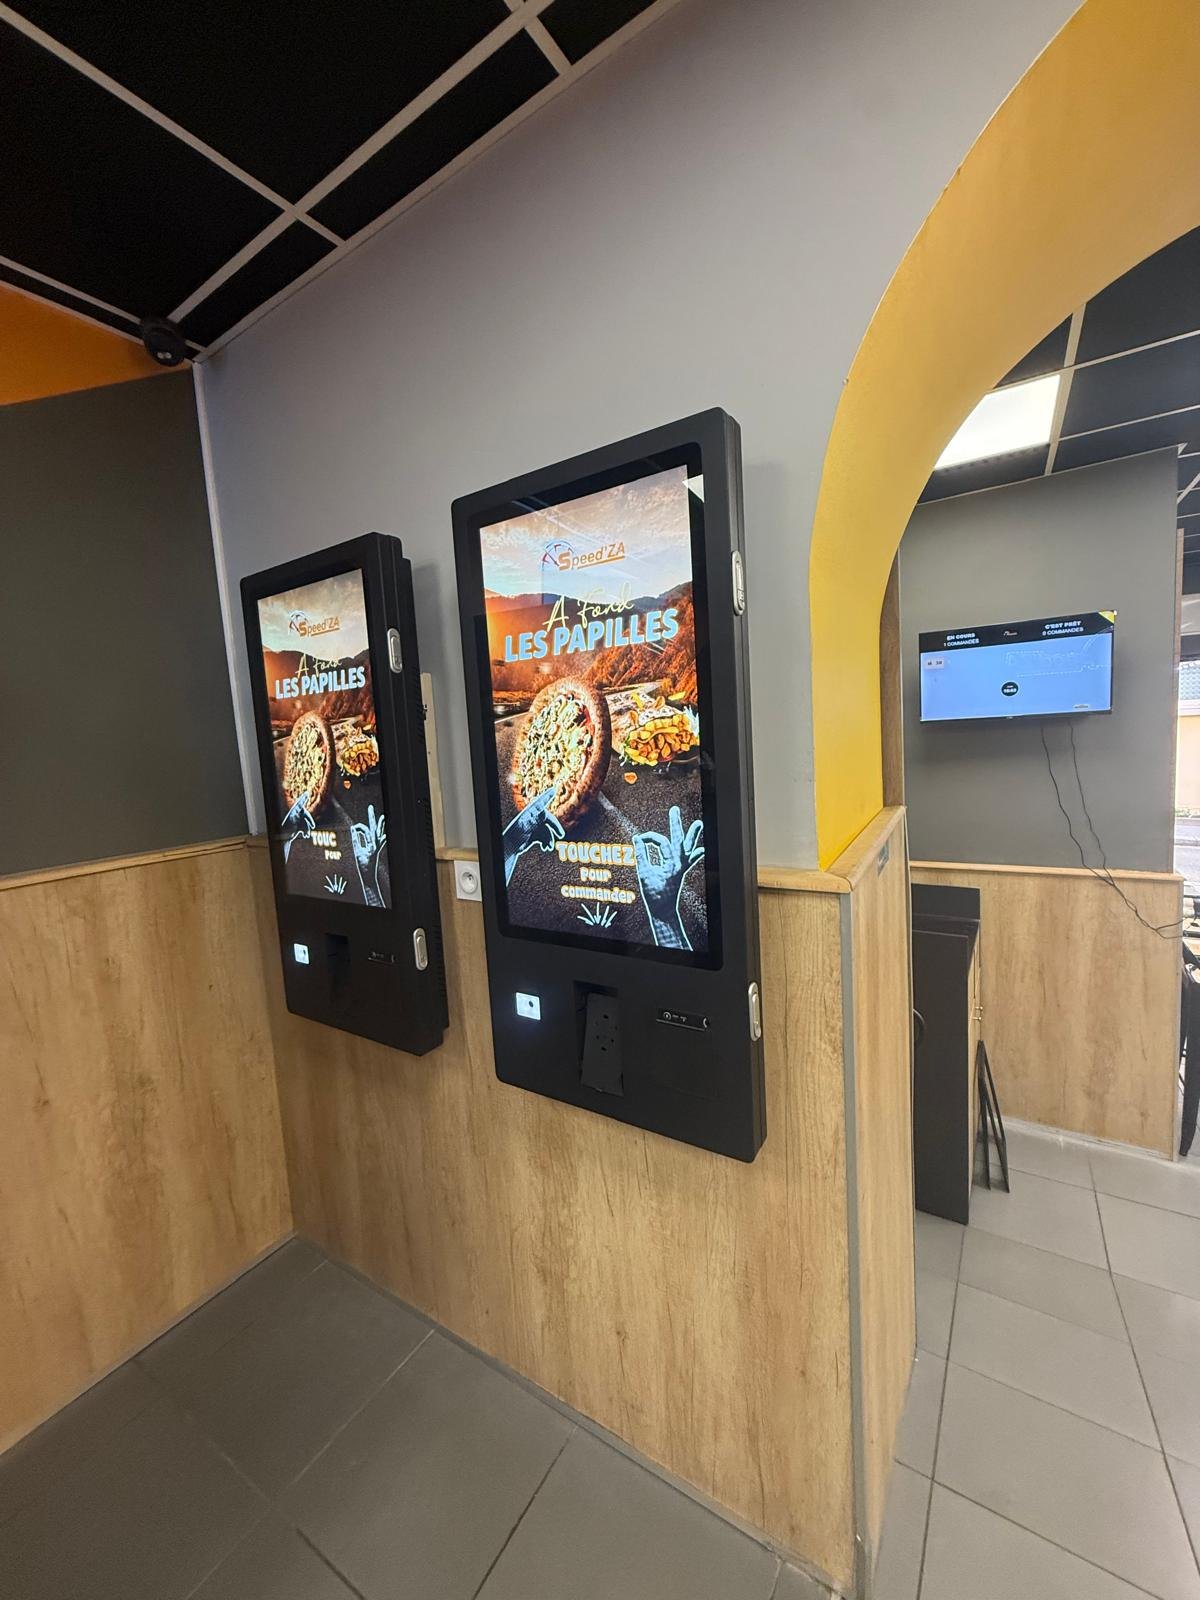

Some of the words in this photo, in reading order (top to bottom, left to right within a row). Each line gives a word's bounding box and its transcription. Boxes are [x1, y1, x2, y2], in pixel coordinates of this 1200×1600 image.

[542, 594, 569, 633] A
[576, 583, 635, 629] Fond
[504, 630, 549, 663] LES
[552, 607, 681, 656] PAPILLES
[294, 652, 310, 679] A
[275, 677, 299, 700] LES
[301, 666, 366, 696] PAPILLES
[555, 841, 636, 866] TOUCHEZ
